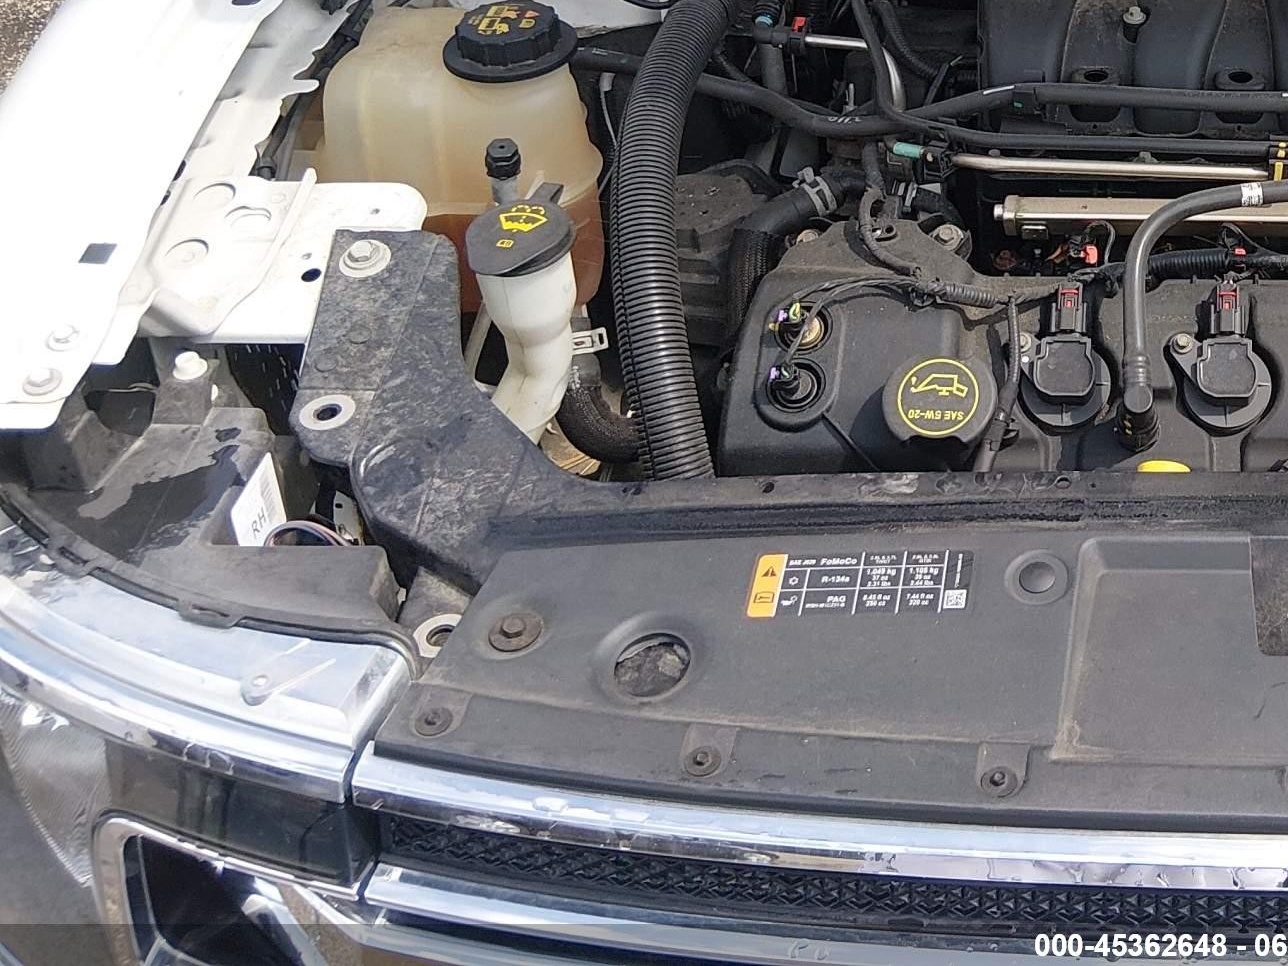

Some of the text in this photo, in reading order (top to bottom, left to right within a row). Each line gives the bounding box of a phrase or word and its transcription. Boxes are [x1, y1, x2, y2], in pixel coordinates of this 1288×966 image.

[908, 409, 964, 421] SAE 5W-20
[820, 557, 858, 566] FoMoCo
[886, 568, 897, 576] kg
[821, 575, 850, 583] R-134a
[826, 595, 846, 603] PAG
